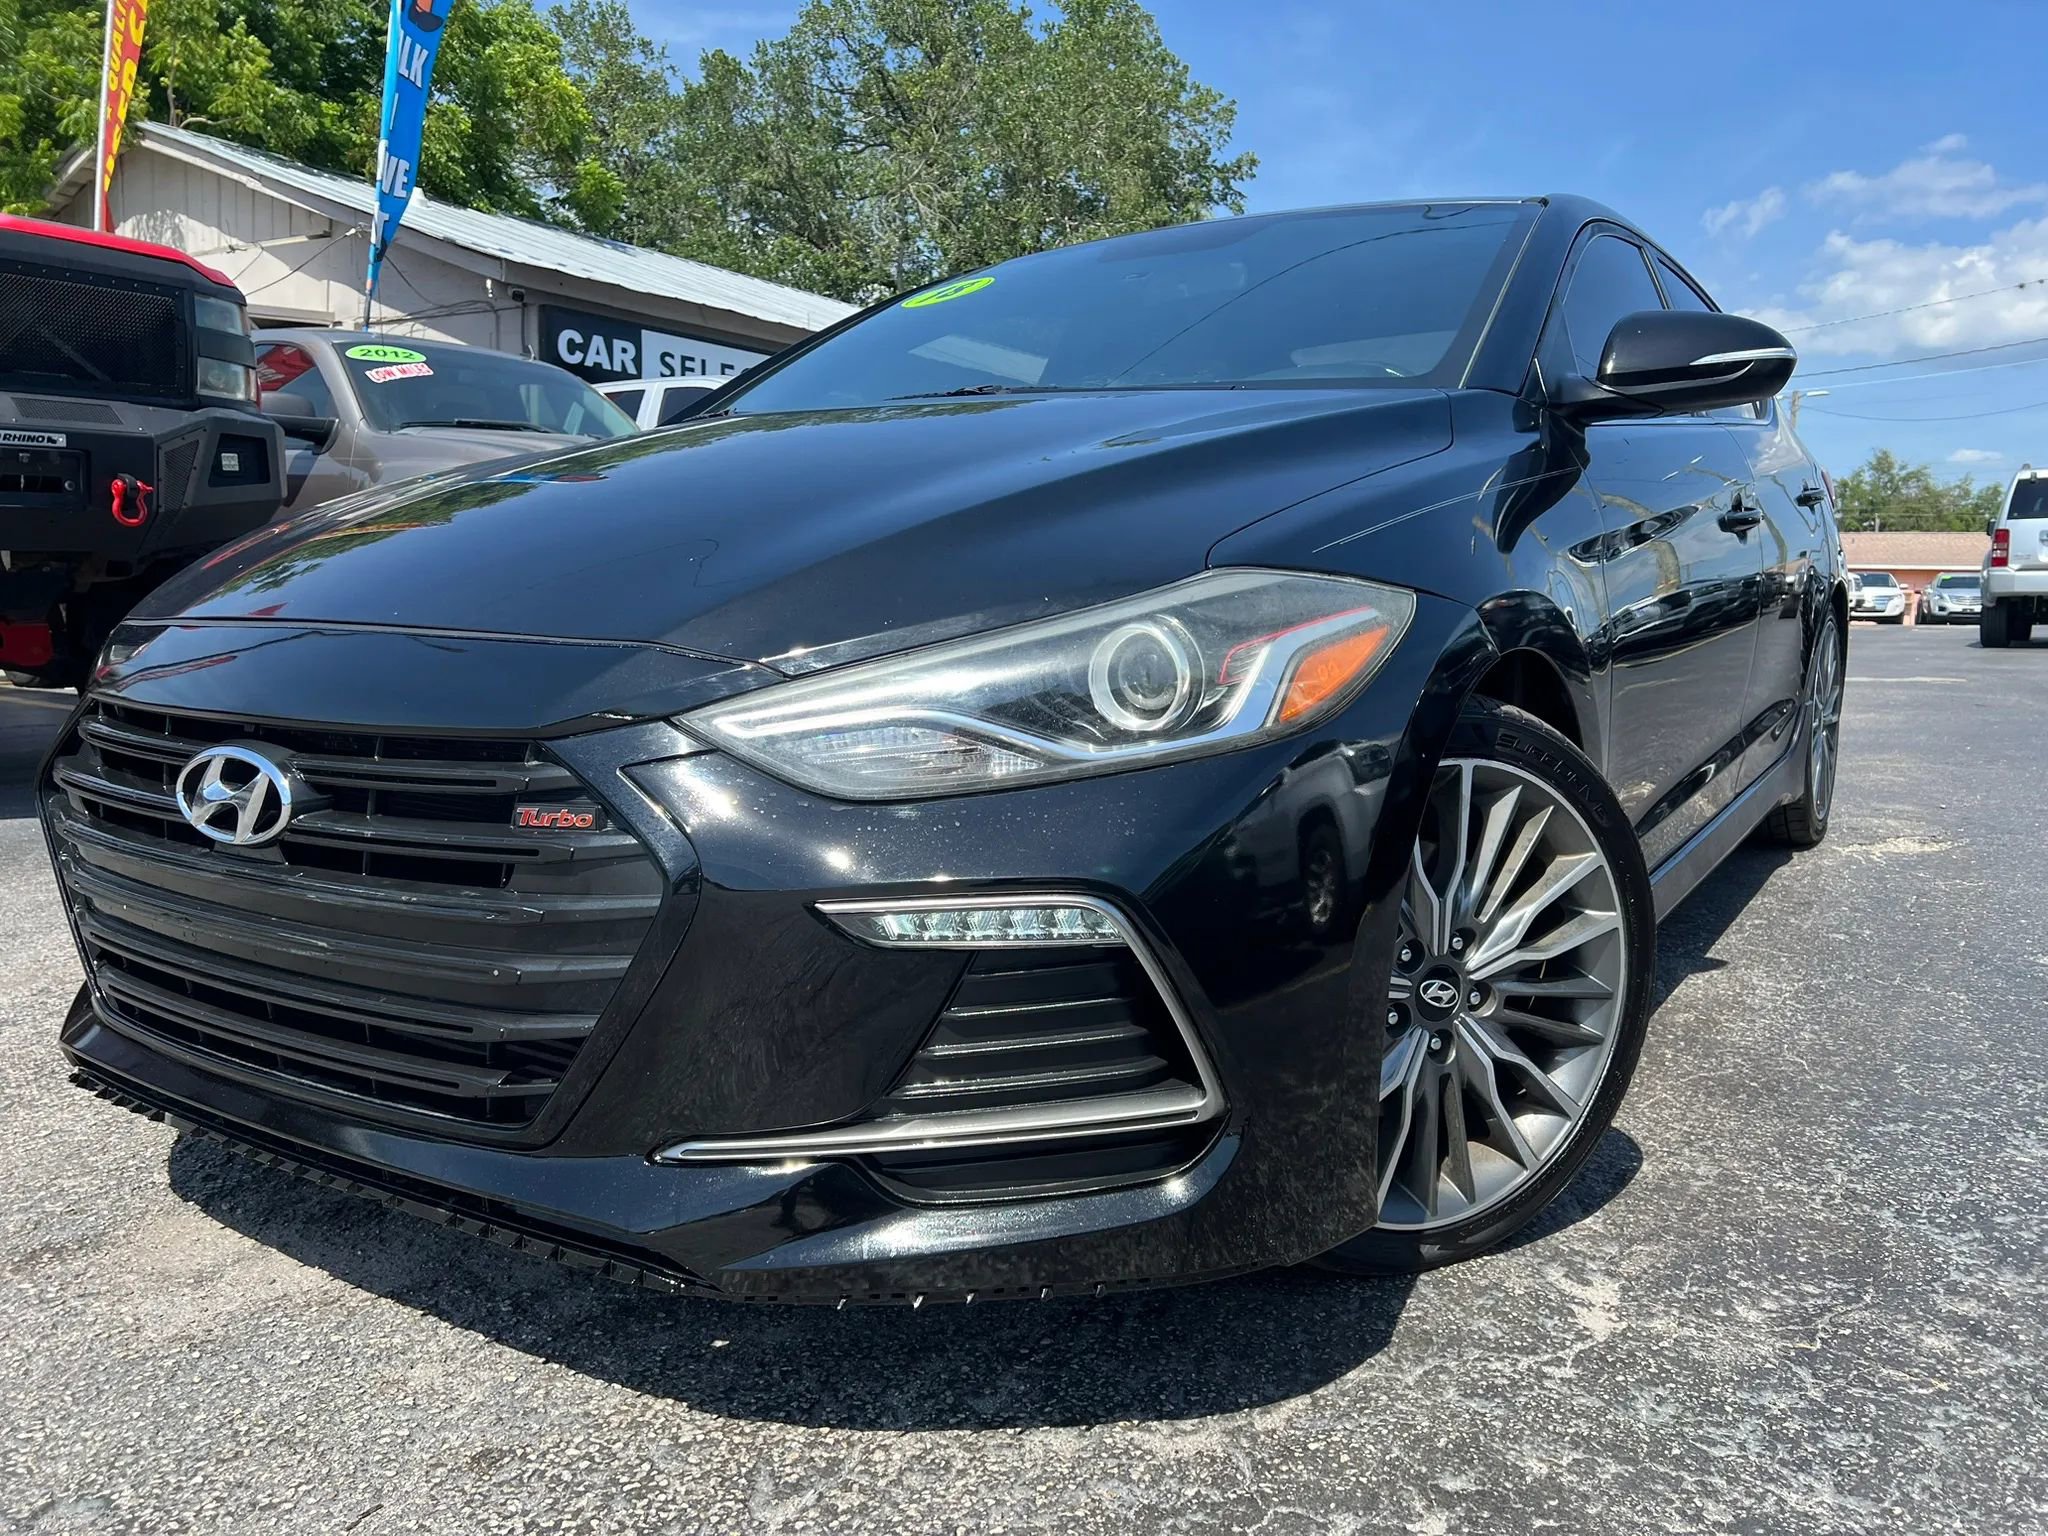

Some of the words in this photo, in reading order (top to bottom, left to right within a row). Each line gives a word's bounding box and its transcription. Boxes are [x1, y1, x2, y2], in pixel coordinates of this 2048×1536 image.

[109, 0, 127, 92] QUALI
[359, 348, 416, 360] 2012
[557, 328, 638, 375] CAR
[2, 433, 46, 444] RHINO
[516, 807, 593, 828] Turbo
